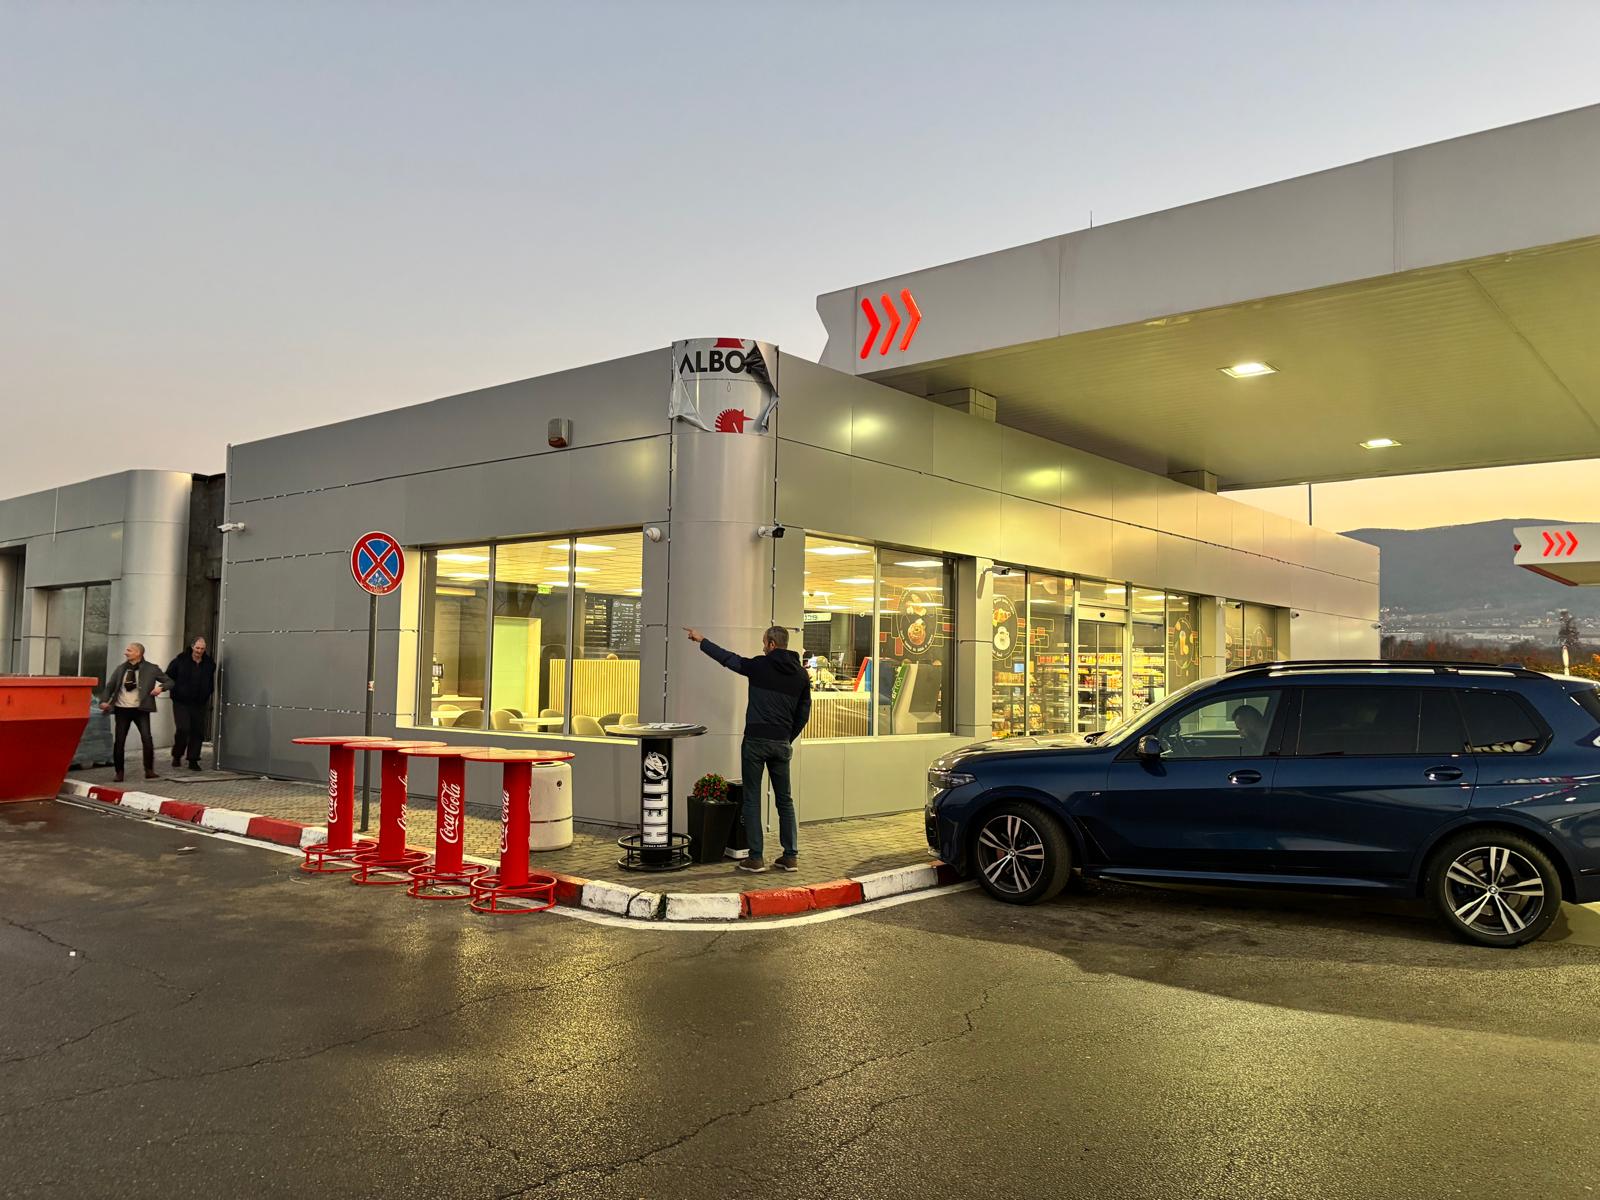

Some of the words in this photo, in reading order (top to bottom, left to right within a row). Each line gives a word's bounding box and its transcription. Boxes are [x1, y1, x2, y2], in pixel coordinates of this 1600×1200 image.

[679, 350, 752, 374] ALBO
[328, 768, 338, 823] CocaCola
[440, 780, 460, 843] Coca-Cola
[643, 779, 669, 843] HELL
